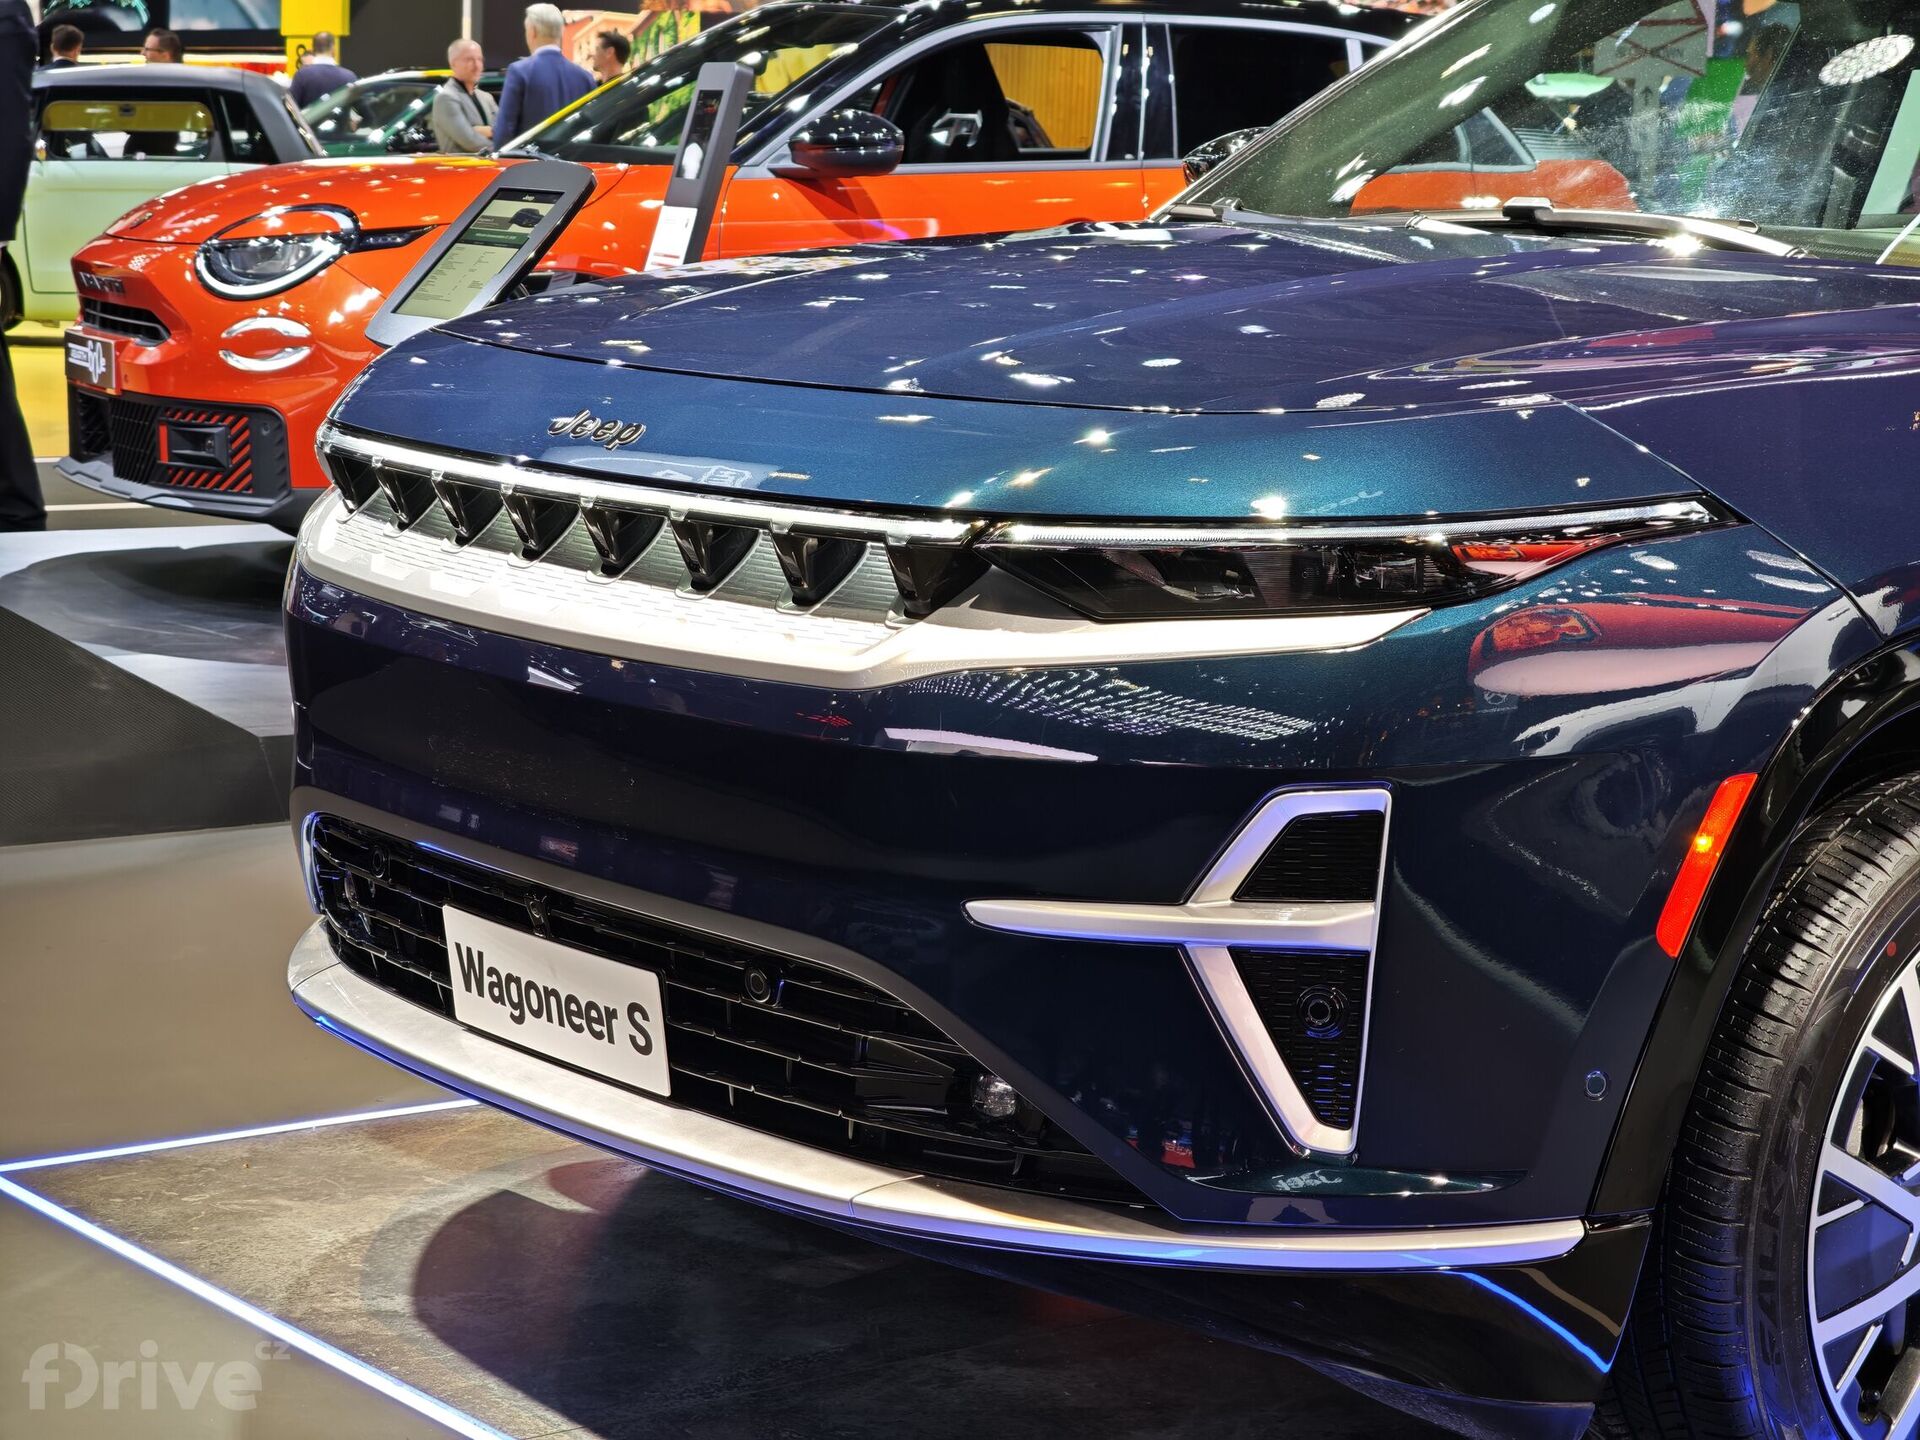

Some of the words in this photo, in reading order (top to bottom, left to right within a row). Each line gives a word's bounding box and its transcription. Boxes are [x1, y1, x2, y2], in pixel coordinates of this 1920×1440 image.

[548, 408, 647, 452] Jeep
[454, 941, 619, 1046] Wagoneer
[626, 1001, 654, 1057] S
